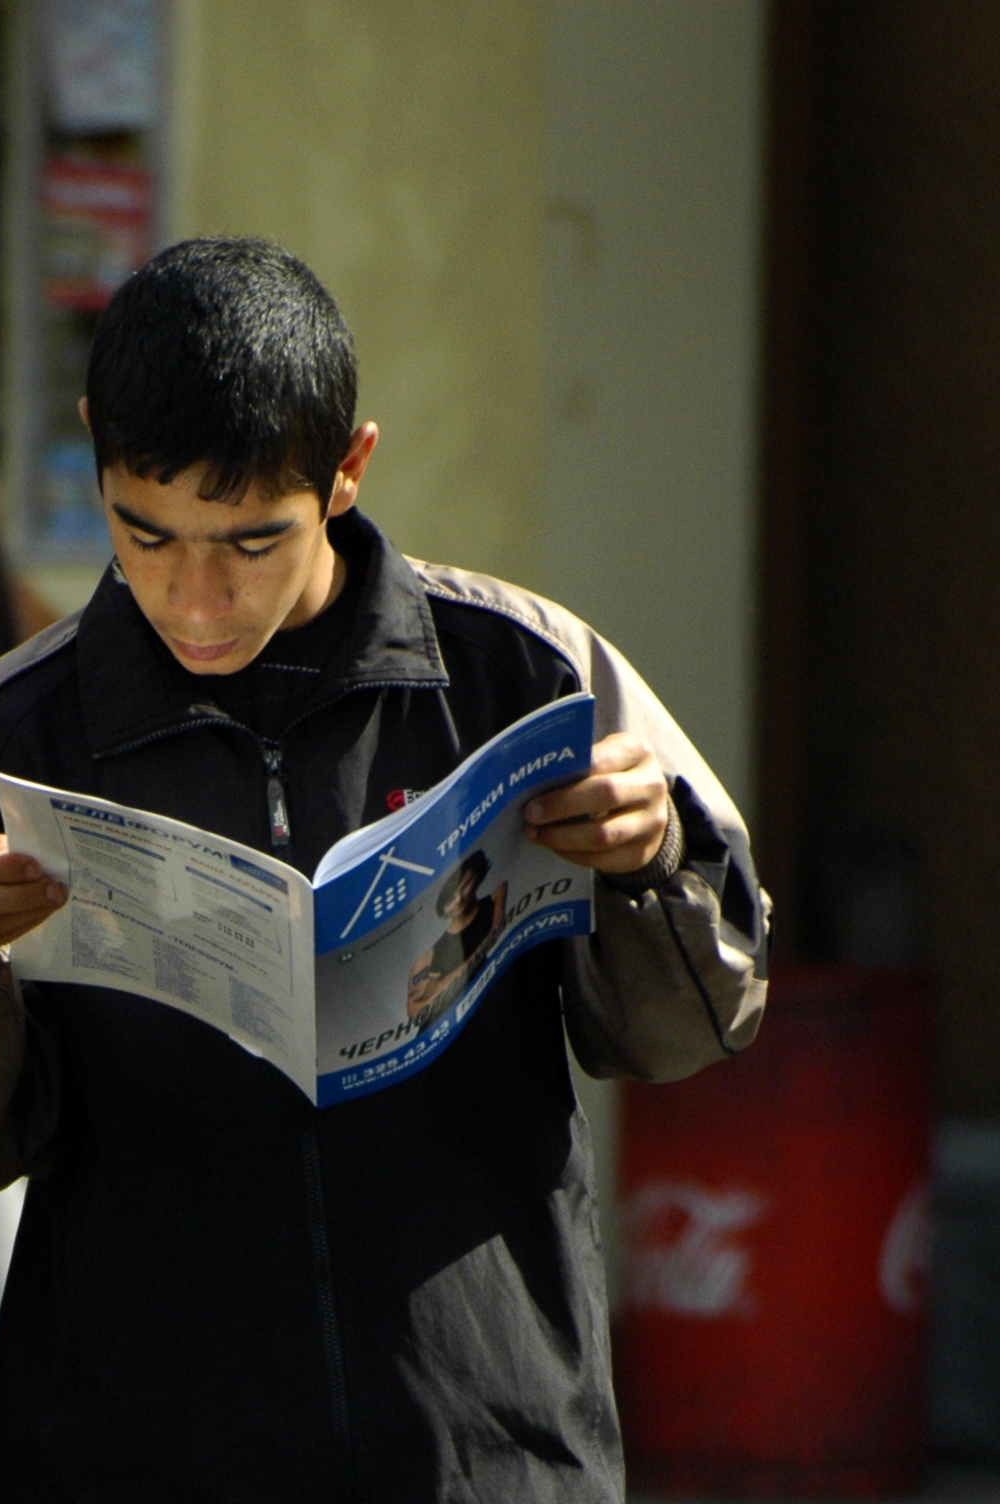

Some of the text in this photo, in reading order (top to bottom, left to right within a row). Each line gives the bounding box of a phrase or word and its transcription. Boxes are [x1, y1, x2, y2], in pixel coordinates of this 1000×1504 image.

[437, 746, 575, 857] ТРУБКИ МИРА
[404, 1041, 426, 1061] 43
[430, 1020, 450, 1042] 43
